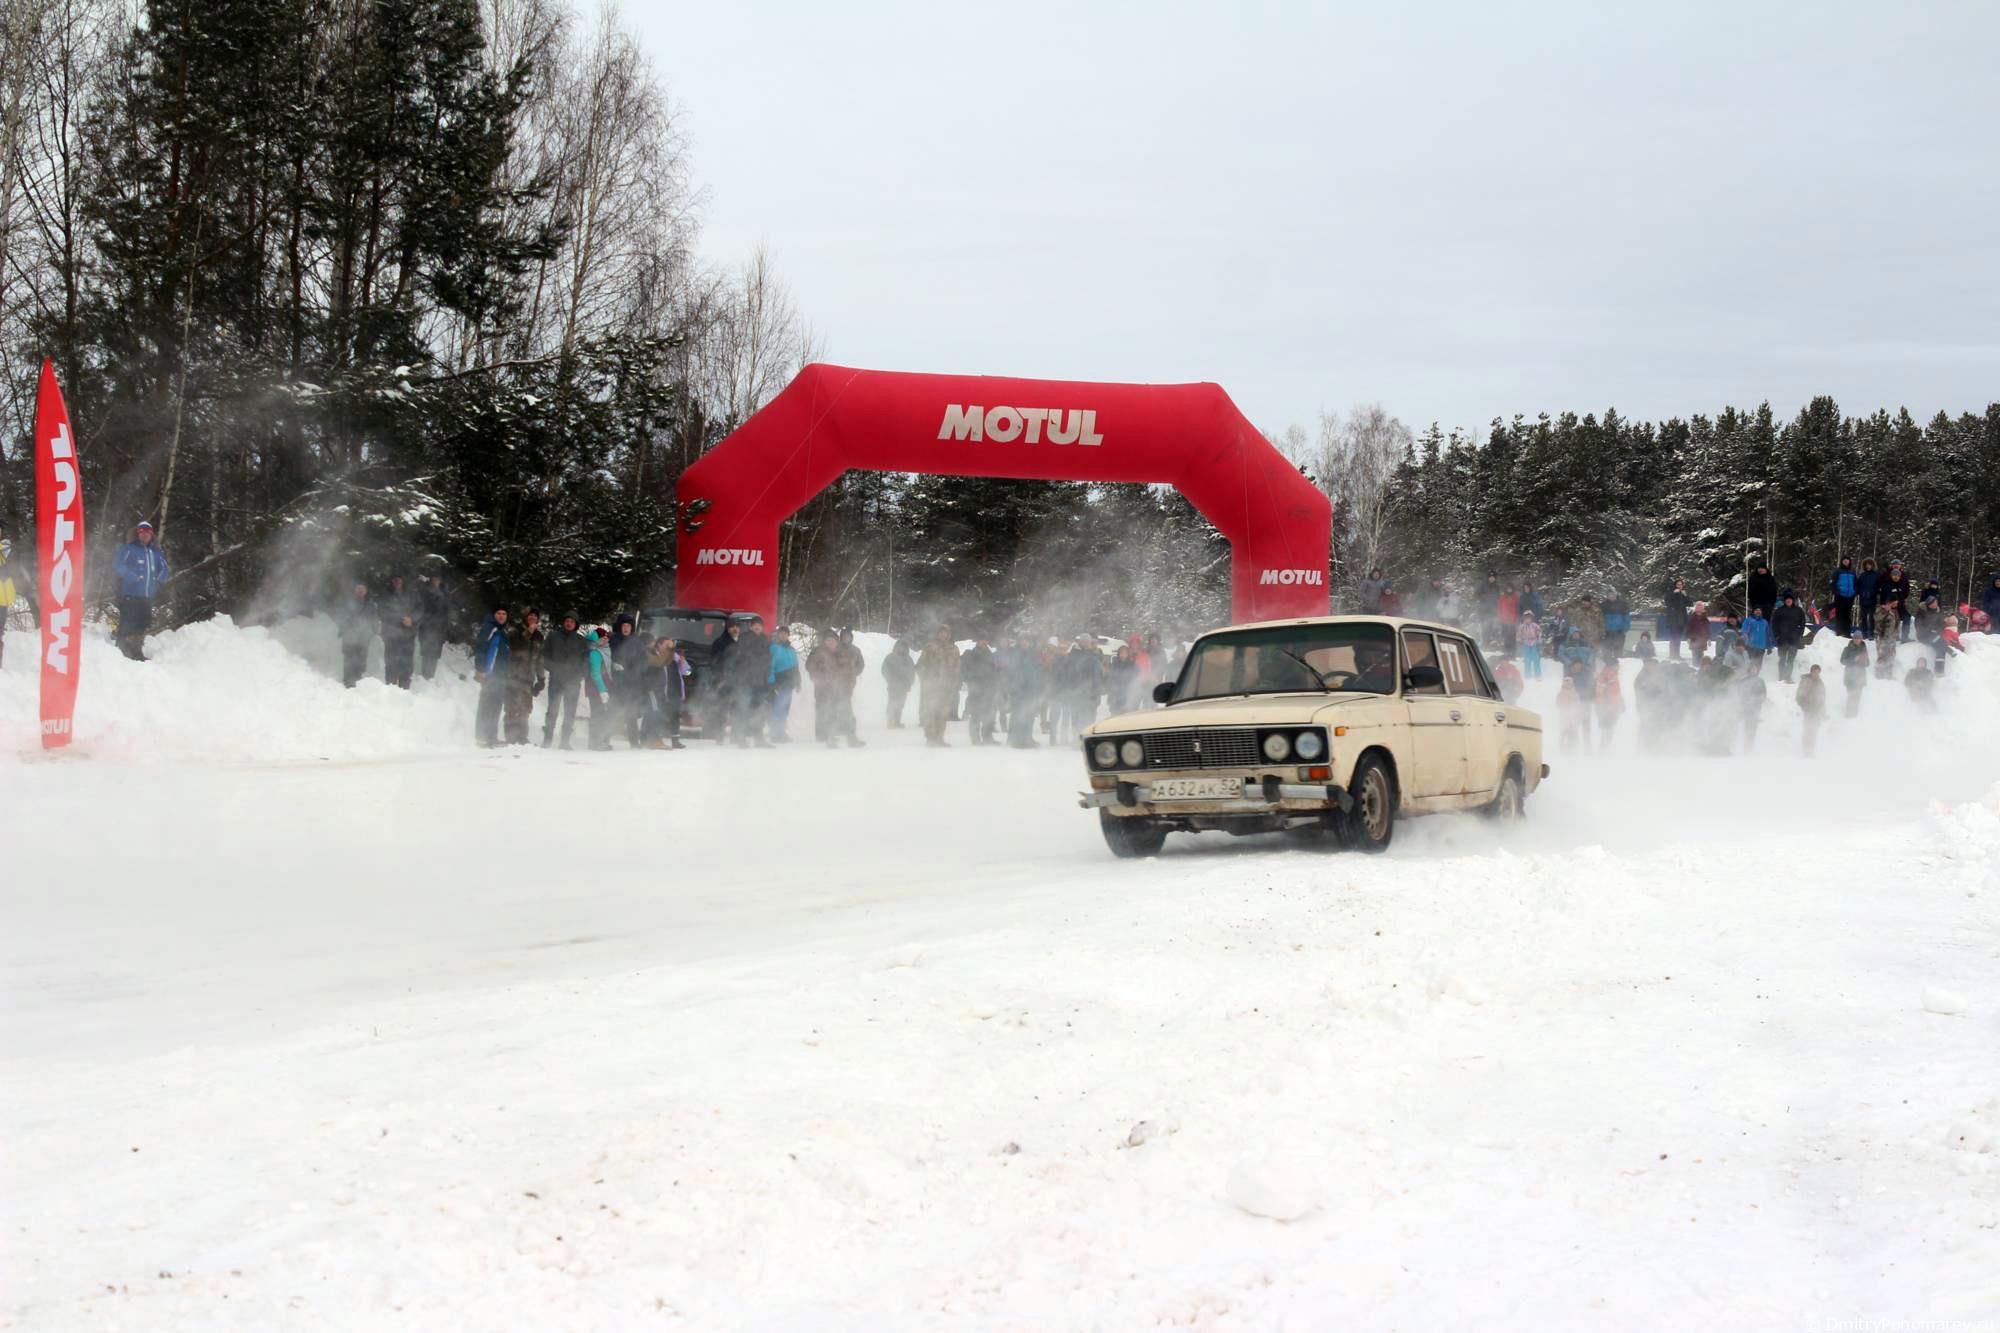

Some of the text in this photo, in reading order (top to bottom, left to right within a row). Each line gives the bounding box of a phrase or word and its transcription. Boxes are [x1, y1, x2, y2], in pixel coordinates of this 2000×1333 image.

[937, 403, 1104, 446] MOTUL
[47, 423, 77, 675] MOTUL
[696, 548, 765, 566] MOTUL
[1260, 569, 1323, 586] MOTUL
[41, 719, 70, 735] OTU
